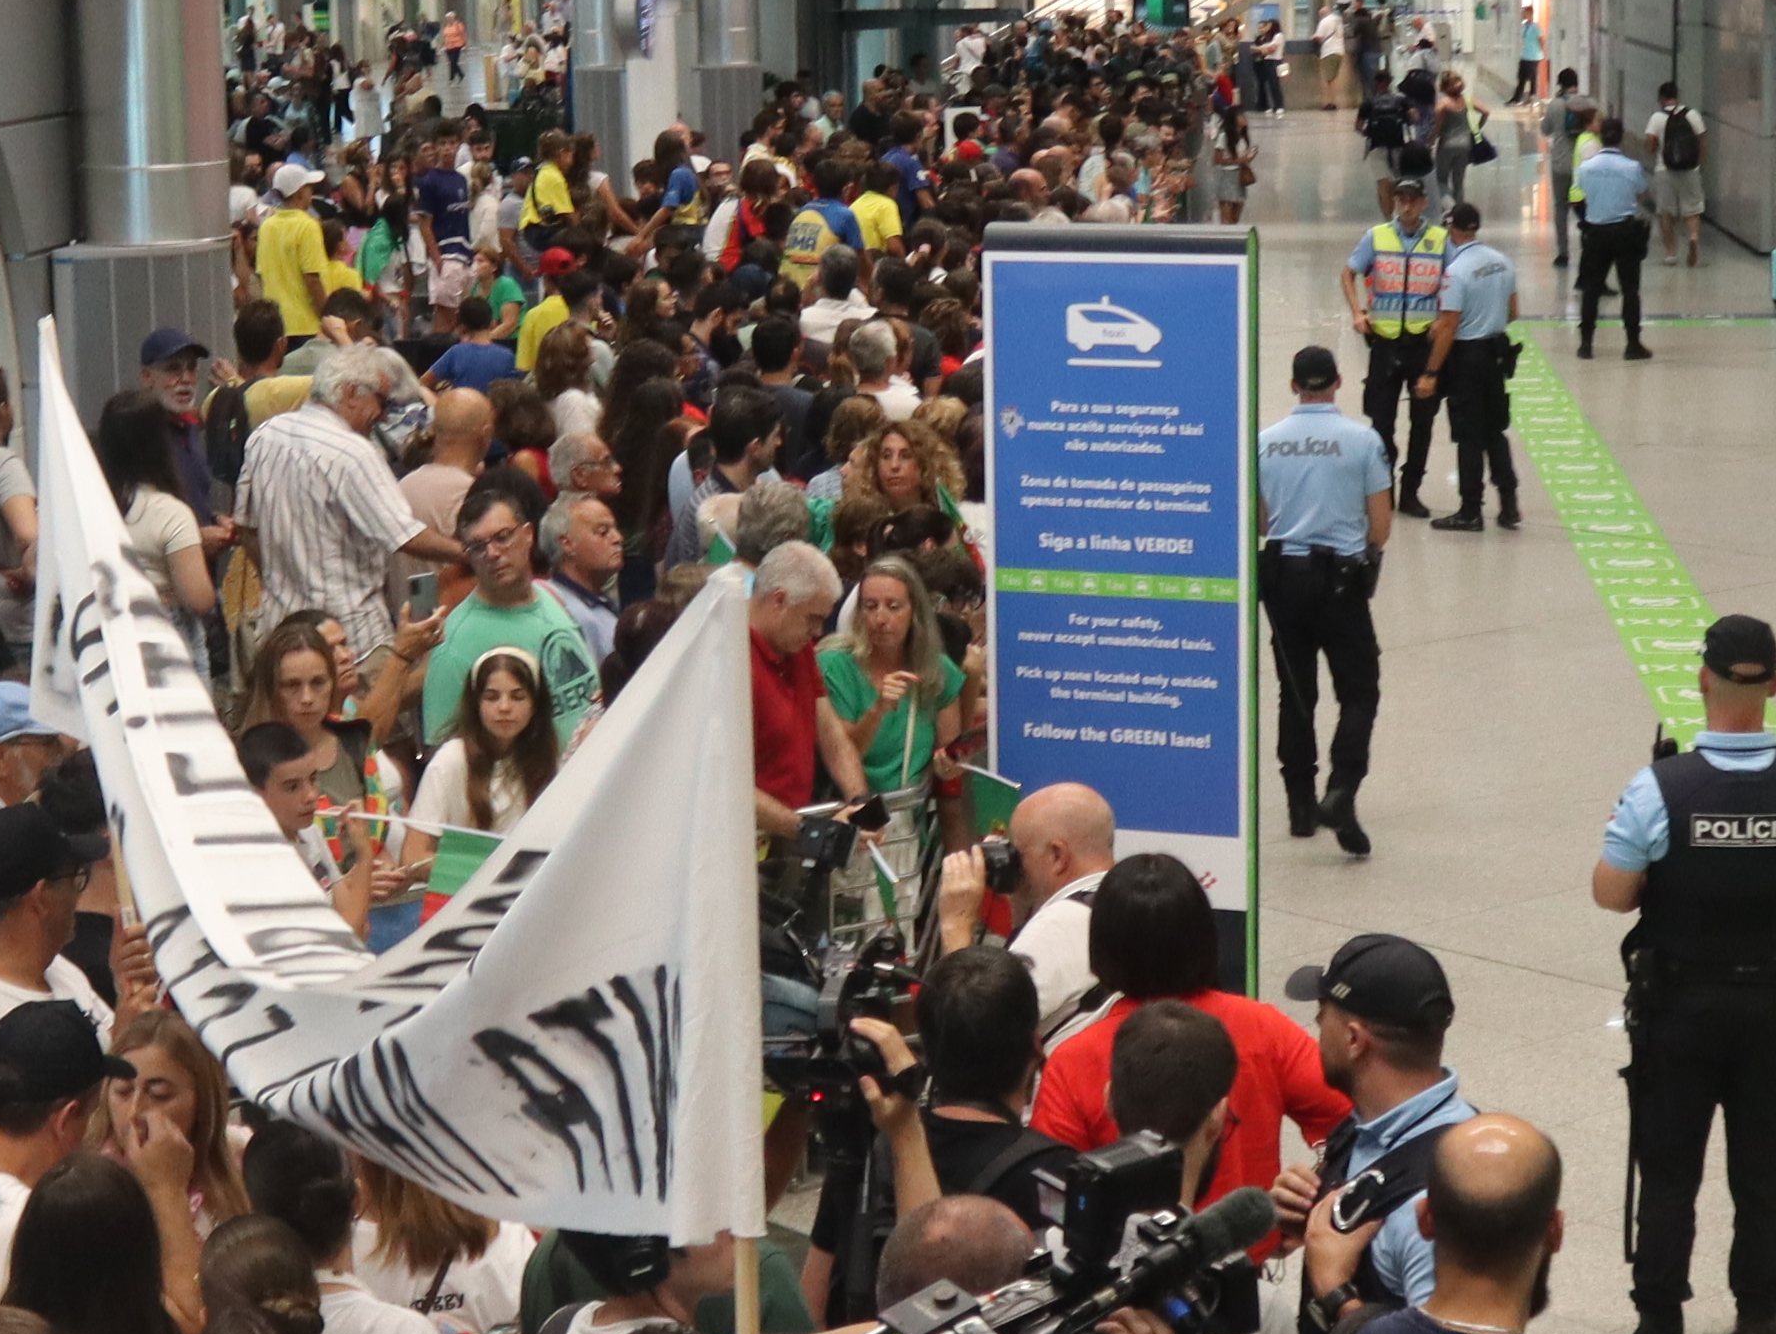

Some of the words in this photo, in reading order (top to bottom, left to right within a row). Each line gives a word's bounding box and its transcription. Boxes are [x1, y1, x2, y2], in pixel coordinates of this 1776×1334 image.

[1051, 400, 1079, 413] Para
[1090, 404, 1113, 414] sua
[1116, 404, 1180, 420] segurança
[1027, 421, 1066, 432] nunca
[1067, 421, 1106, 433] aceite
[1108, 422, 1159, 438] serviços
[1161, 423, 1177, 435] de
[1064, 439, 1088, 452] não
[1089, 440, 1166, 454] autorizados.
[1266, 436, 1342, 458] POLÍCIA
[1020, 475, 1051, 487] Zona
[1052, 476, 1069, 488] de
[1071, 477, 1118, 490] tomada
[1119, 479, 1136, 491] de
[1137, 482, 1212, 496] passageiros
[1020, 496, 1065, 508] apenas
[1066, 497, 1083, 508] no
[1084, 497, 1134, 509] exterior
[1135, 498, 1153, 510] do
[1154, 500, 1212, 513] terminal.
[1038, 532, 1074, 553] Siga
[1076, 537, 1087, 550] a
[1090, 534, 1132, 552] linha
[1134, 536, 1195, 555] VERDE!
[1068, 612, 1090, 626] For
[1091, 616, 1120, 629] your
[1121, 616, 1164, 633] safety,
[1018, 631, 1054, 643] never
[1055, 633, 1096, 647] accept
[1097, 634, 1180, 650] unauthorized
[1015, 665, 1043, 679] Pick
[1044, 670, 1062, 683] up
[1062, 671, 1093, 682] zone
[1094, 670, 1140, 685] located
[1142, 674, 1169, 690] only
[1170, 675, 1219, 690] outside
[1050, 687, 1072, 699] the
[1073, 688, 1126, 703] terminal
[1127, 691, 1183, 709] building.
[1023, 721, 1077, 740] Follow
[1079, 726, 1108, 743] the
[1110, 728, 1167, 747] GREEN
[1170, 732, 1212, 750] lane!
